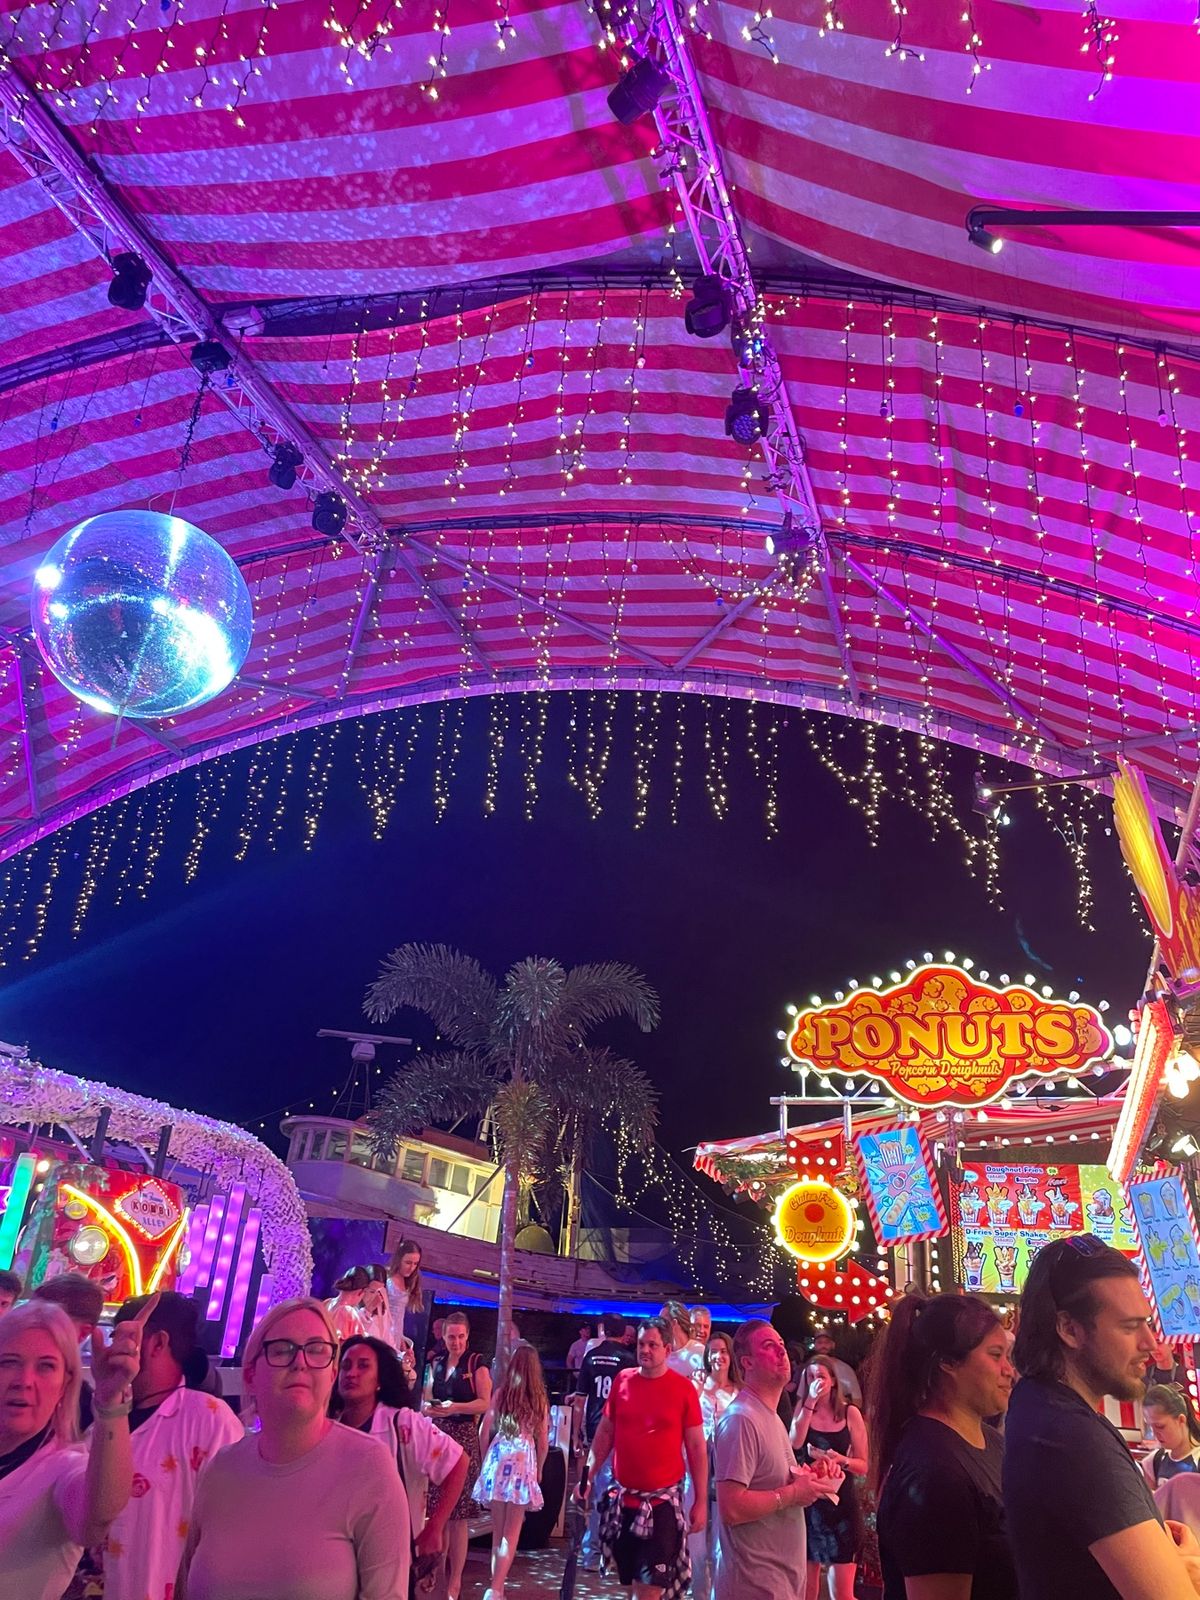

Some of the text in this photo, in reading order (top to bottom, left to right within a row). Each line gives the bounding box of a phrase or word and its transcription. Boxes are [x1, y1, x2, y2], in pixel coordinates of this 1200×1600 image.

[812, 1012, 1078, 1060] PONUTS
[890, 1058, 1003, 1081] Popcorn Doughnuts
[986, 1165, 1022, 1174] Doughnut
[1023, 1166, 1043, 1174] Fries
[142, 1217, 165, 1227] ALLEY
[994, 1229, 1017, 1237] Super
[1019, 1230, 1048, 1238] Shakes
[595, 1375, 612, 1399] 18
